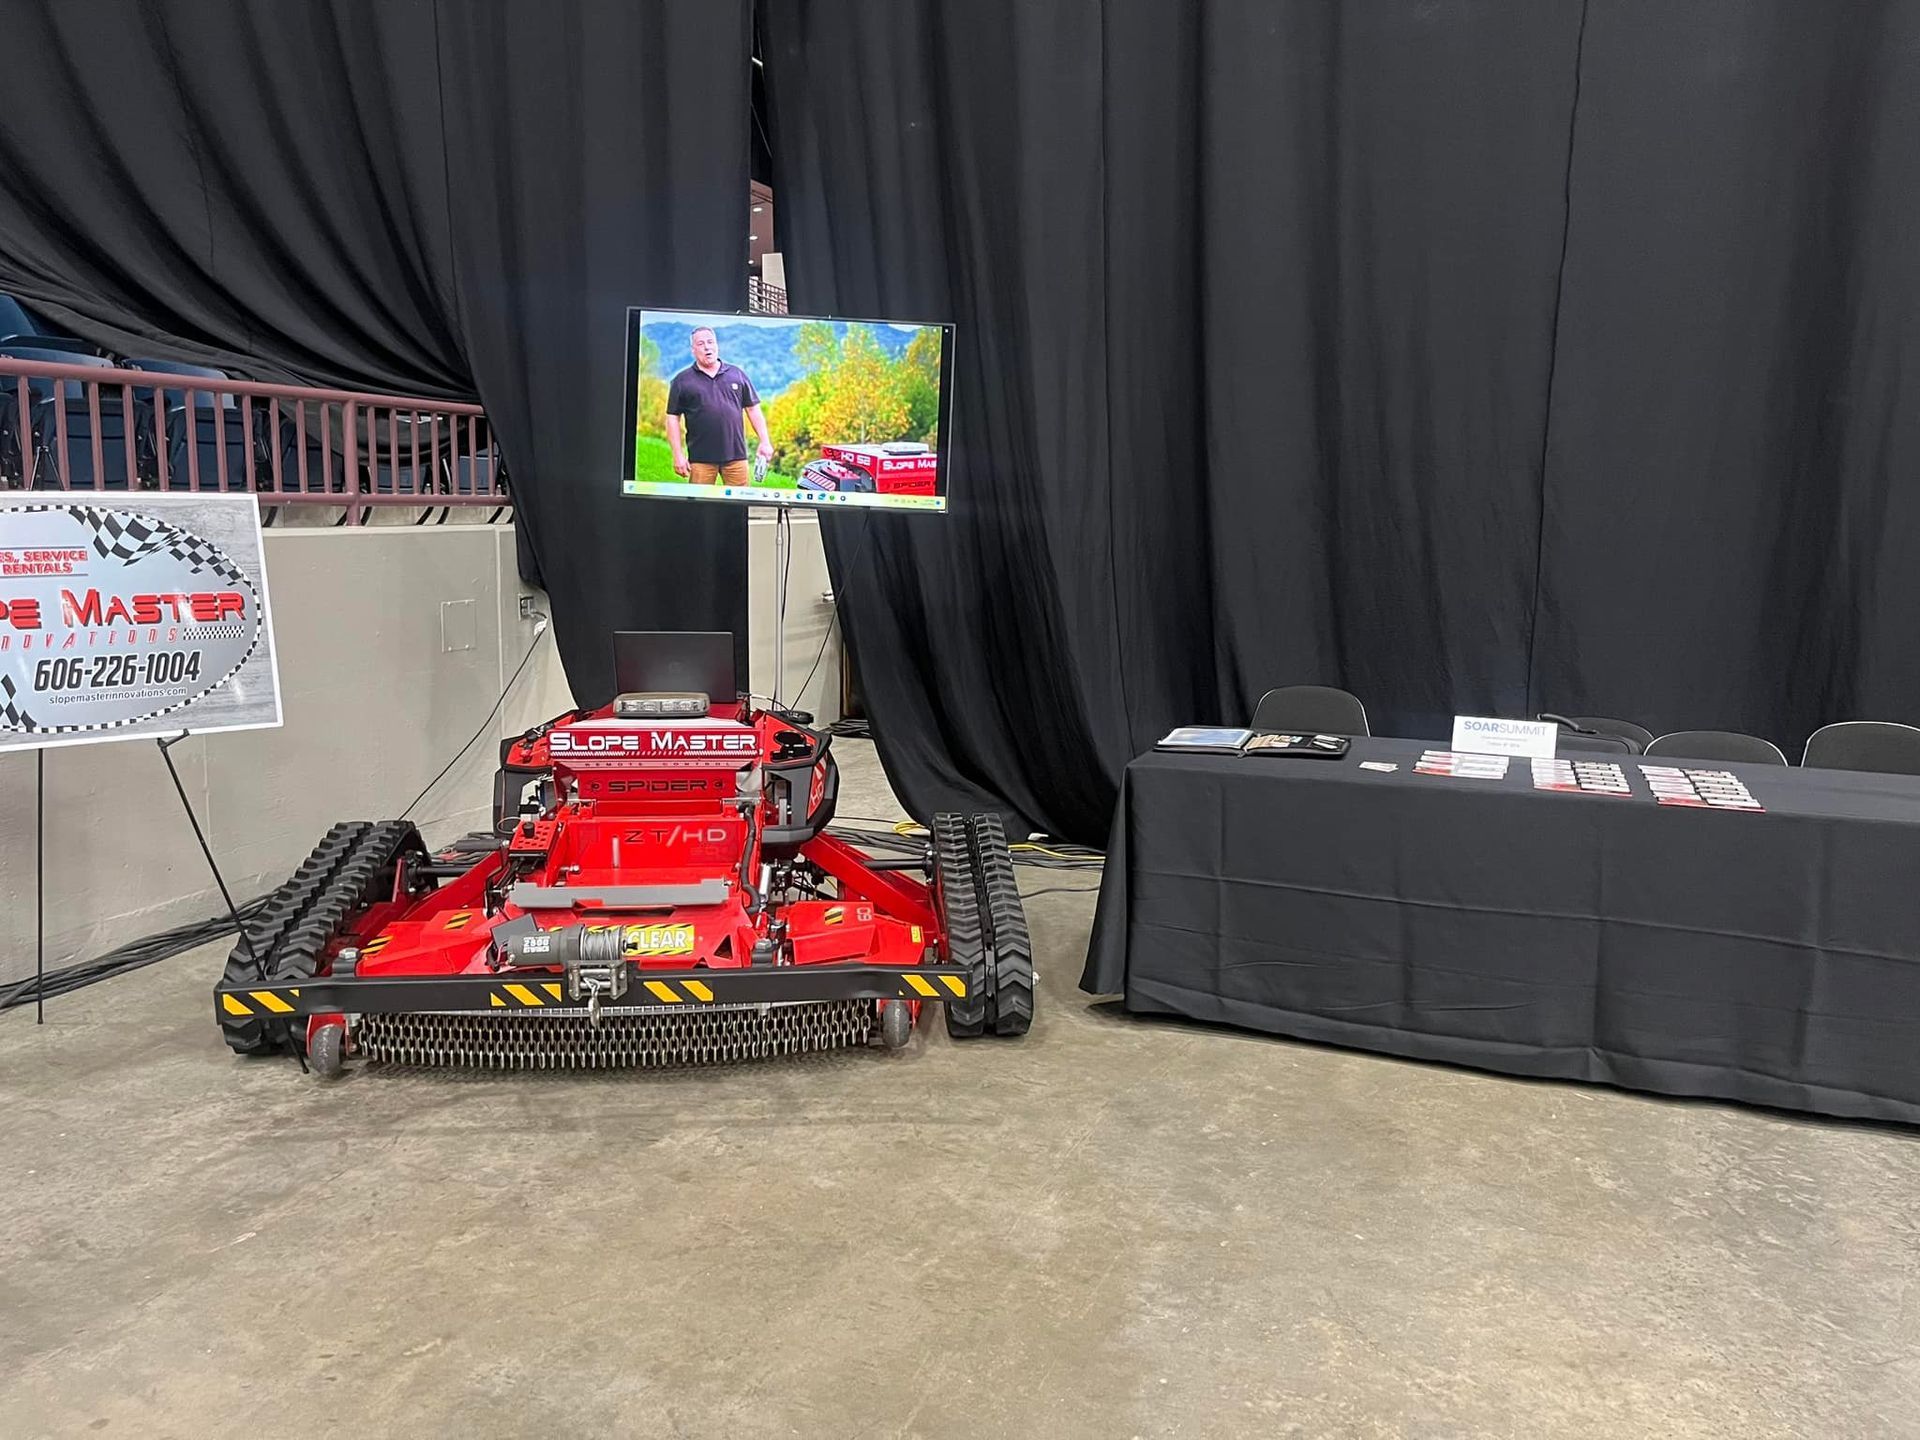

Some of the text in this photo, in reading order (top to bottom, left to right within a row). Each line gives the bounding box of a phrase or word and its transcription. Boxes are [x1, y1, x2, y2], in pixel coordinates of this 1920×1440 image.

[23, 550, 88, 562] SERVICE
[3, 562, 73, 575] RENTALS
[34, 651, 201, 691] 606-226-1004
[49, 687, 187, 704] slopemasterinnovations.com
[549, 731, 756, 750] SLOPE MASTER
[608, 780, 707, 793] SPIDER
[627, 929, 686, 948] CLEAR
